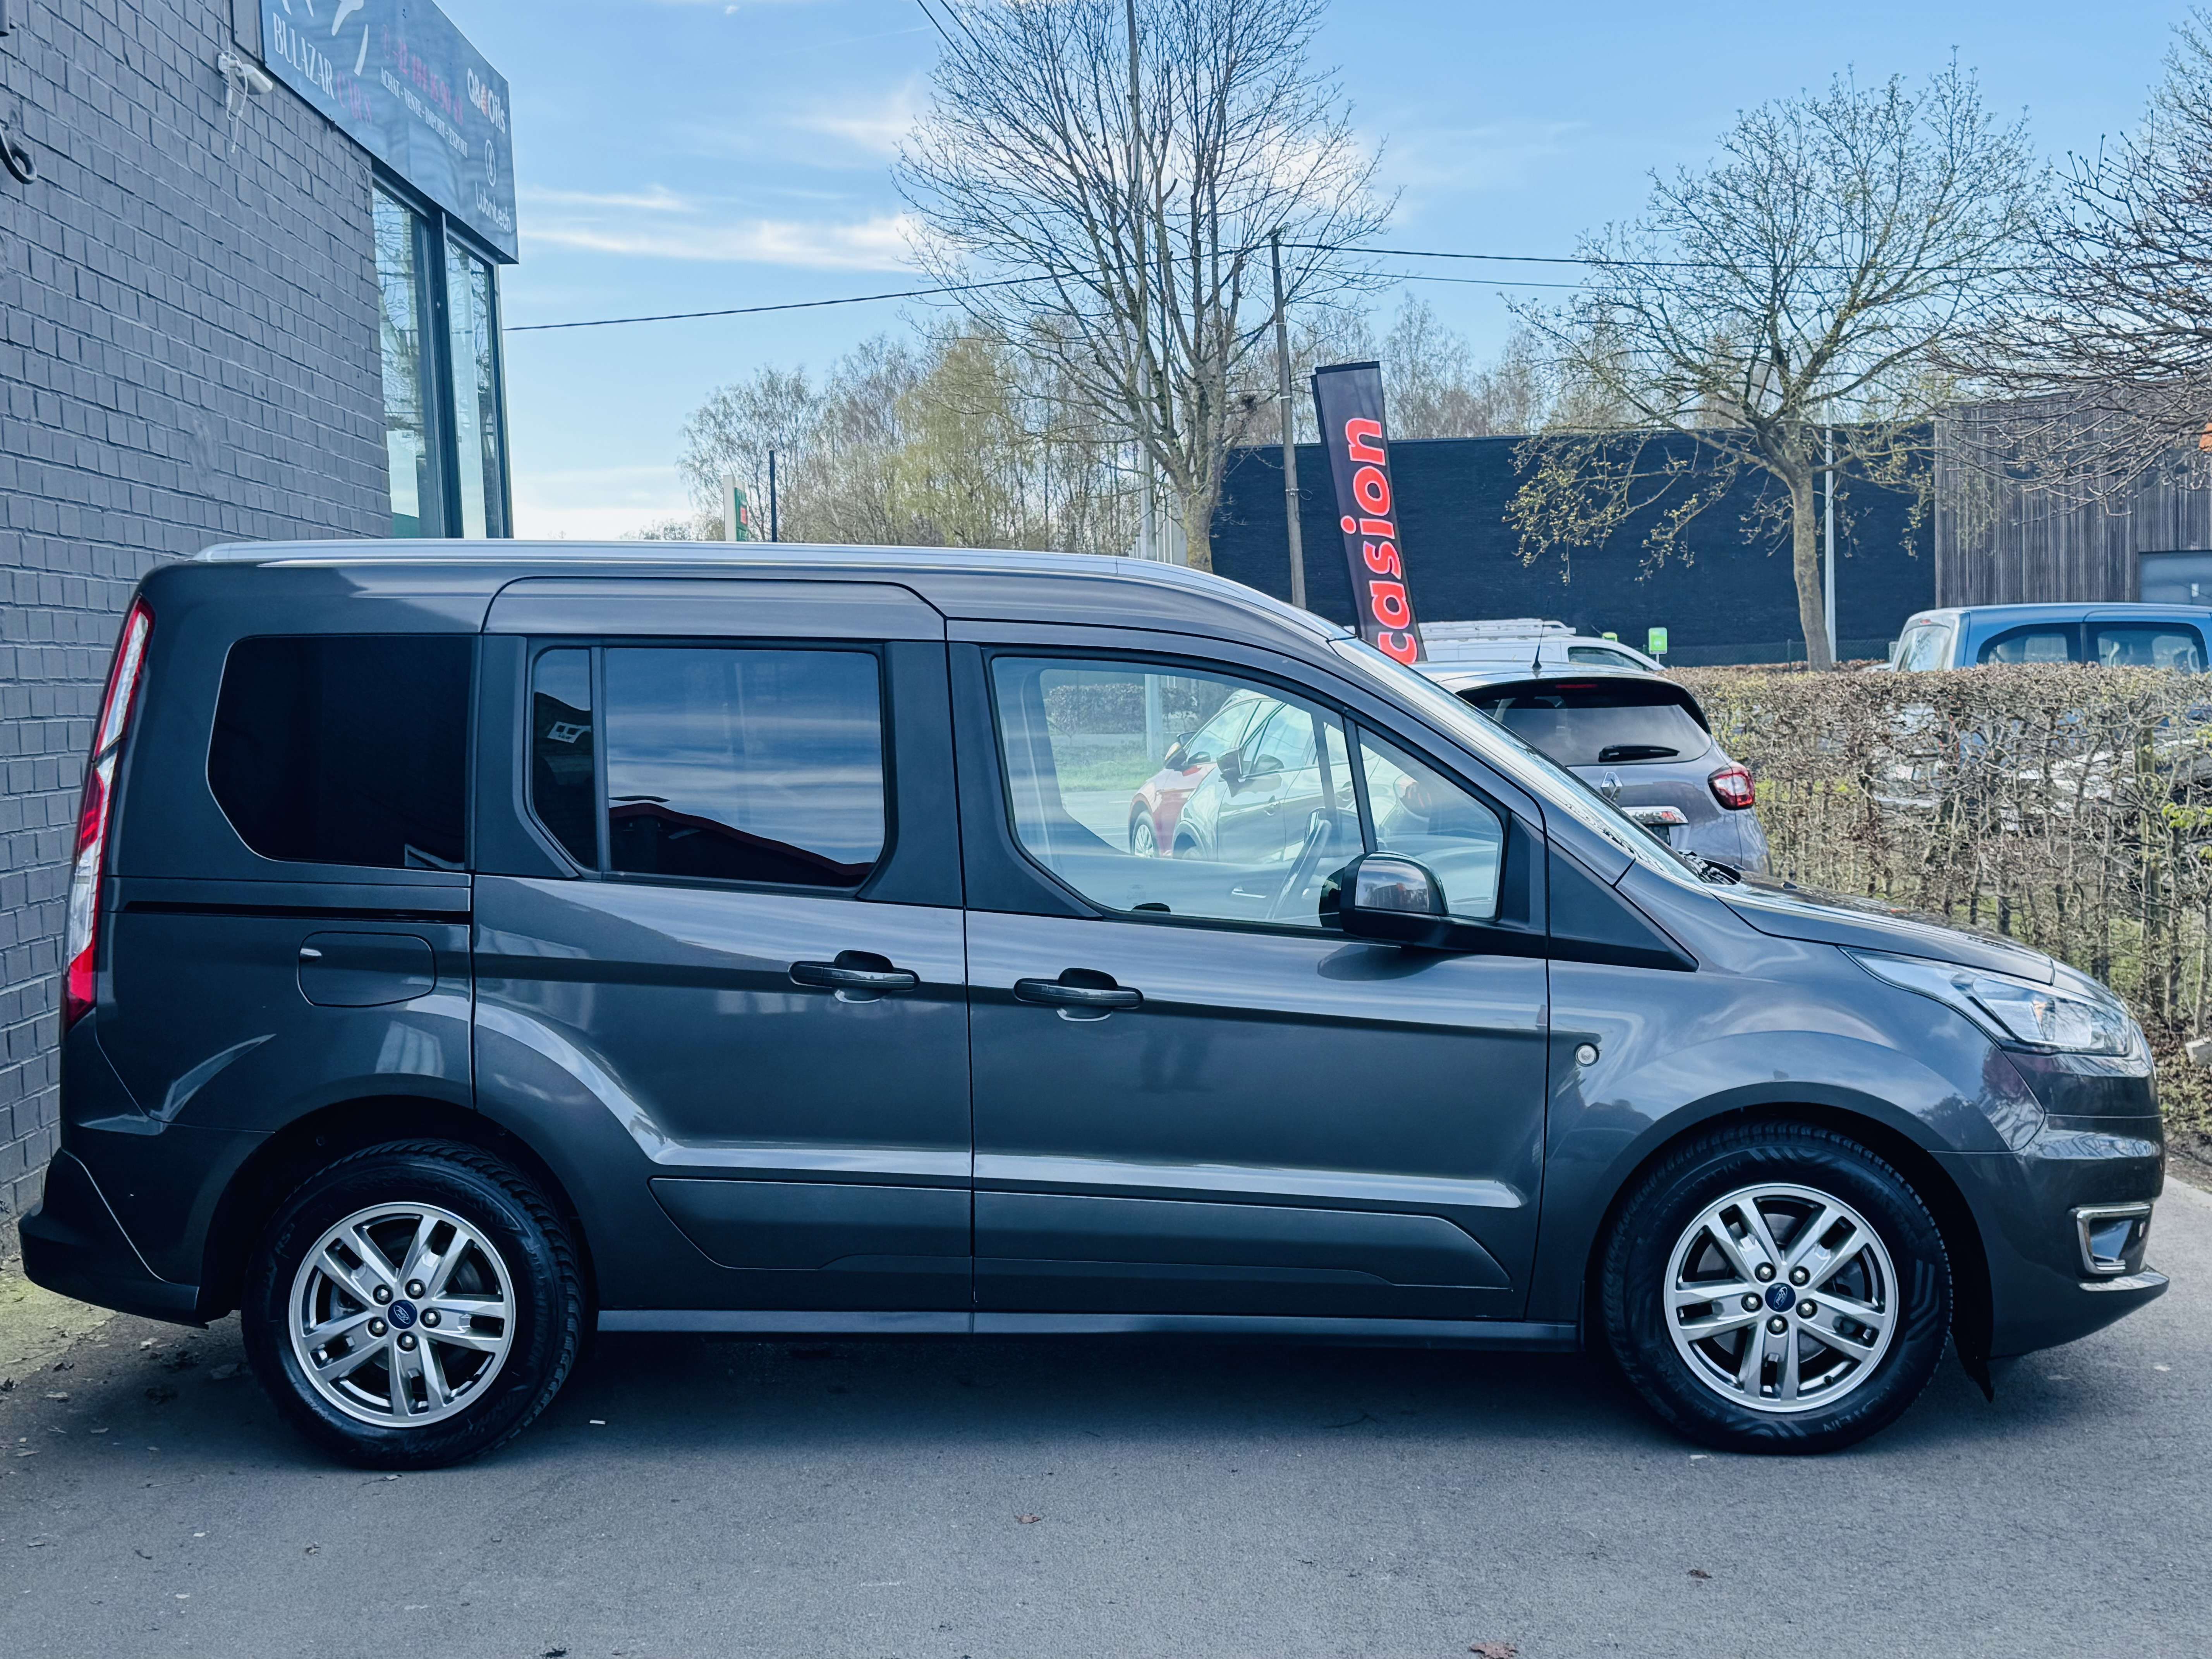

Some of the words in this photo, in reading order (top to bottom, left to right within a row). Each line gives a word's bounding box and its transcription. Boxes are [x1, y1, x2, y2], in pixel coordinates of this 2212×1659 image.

[273, 12, 335, 100] BULAZAR
[381, 67, 400, 98] ACHAT
[404, 87, 422, 118] VENTE
[467, 68, 481, 109] Q8
[488, 89, 505, 134] Oils
